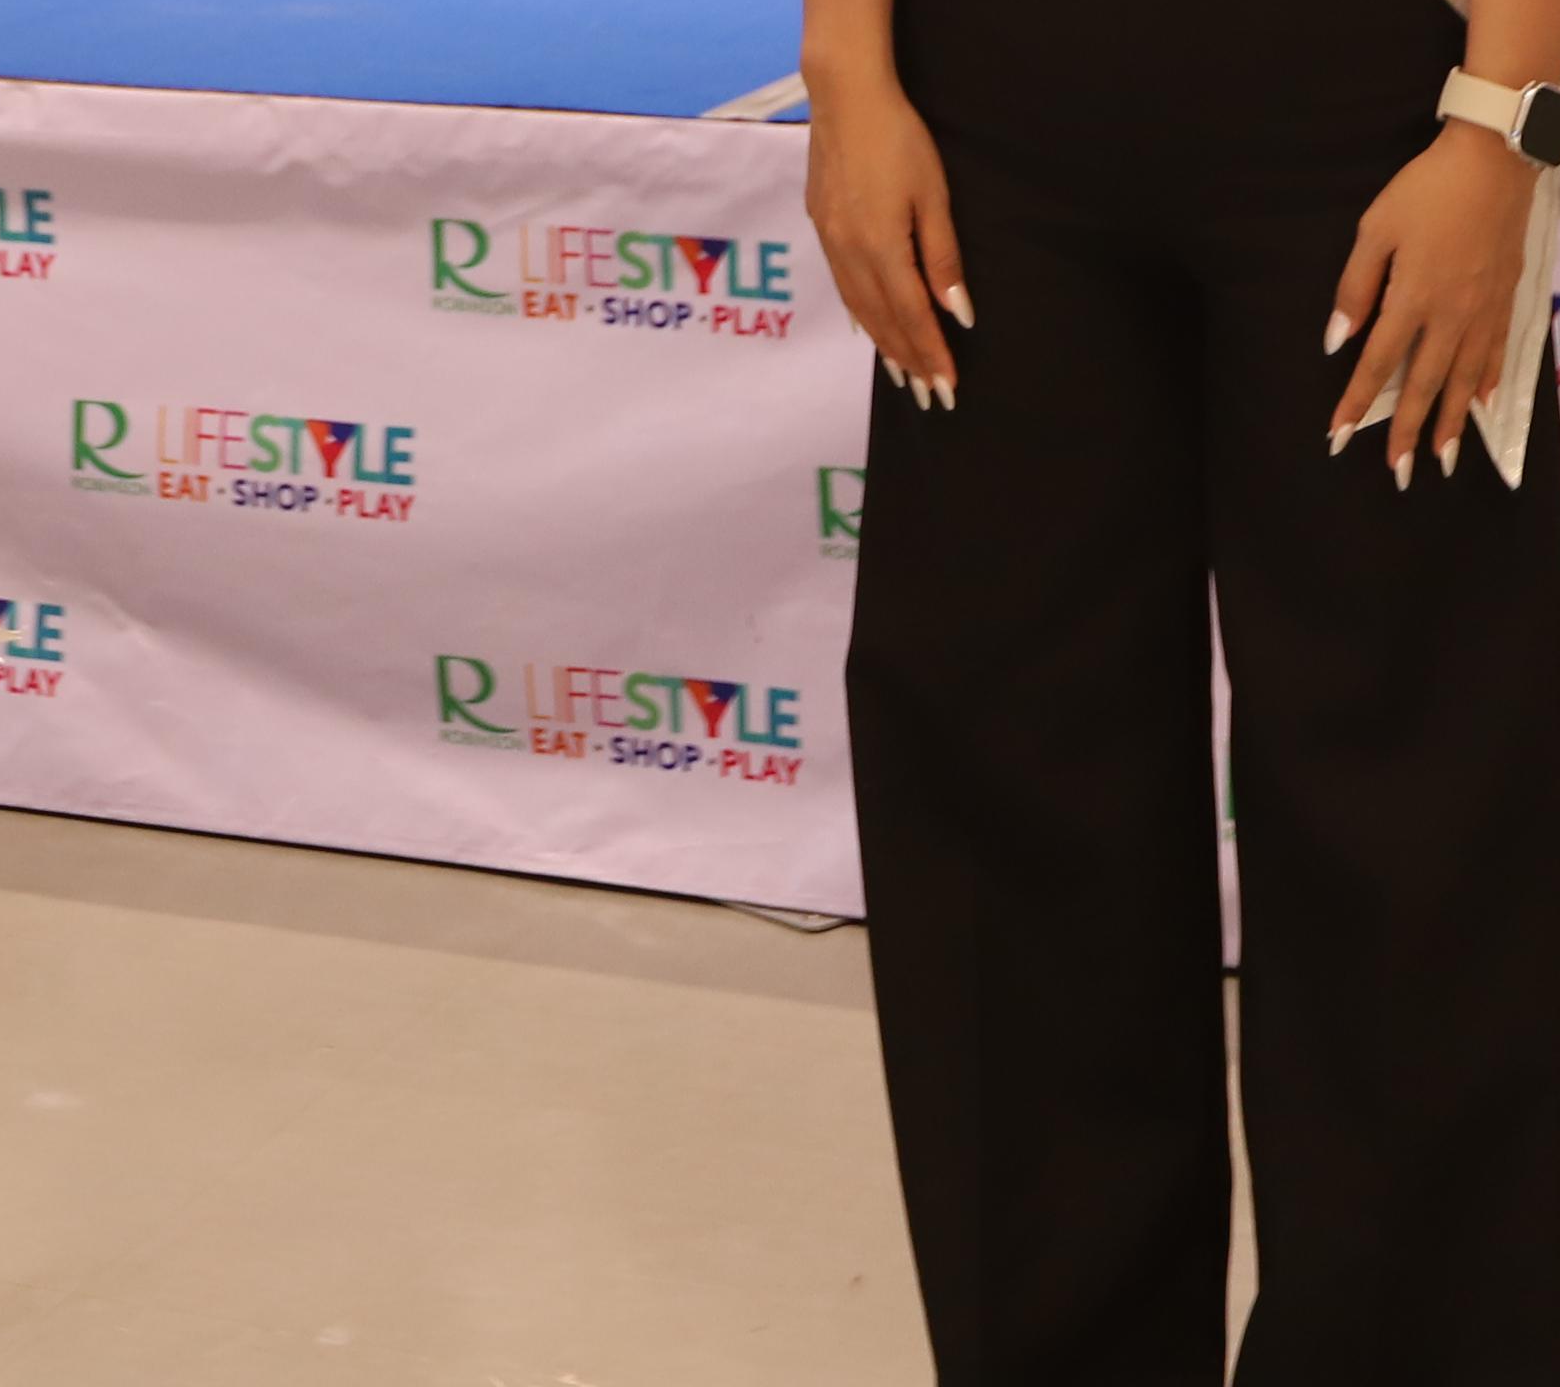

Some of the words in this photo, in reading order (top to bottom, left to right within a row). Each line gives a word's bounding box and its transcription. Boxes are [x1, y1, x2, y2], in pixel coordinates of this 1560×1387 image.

[433, 217, 509, 299] R
[520, 225, 793, 302] LIFESTYLE
[522, 290, 578, 320] EAT
[601, 296, 693, 328] SHOP
[710, 304, 794, 340] PLAY
[72, 399, 145, 480] R
[156, 404, 416, 486] LIFESTYLE
[157, 471, 211, 502] EAT
[232, 478, 319, 512] SHOP
[336, 488, 416, 522] PLAY
[435, 655, 519, 734] R
[524, 662, 802, 749] LIFESTYLE
[531, 727, 588, 759] EAT
[609, 734, 703, 772] SHOP
[719, 748, 802, 785] PLAY
